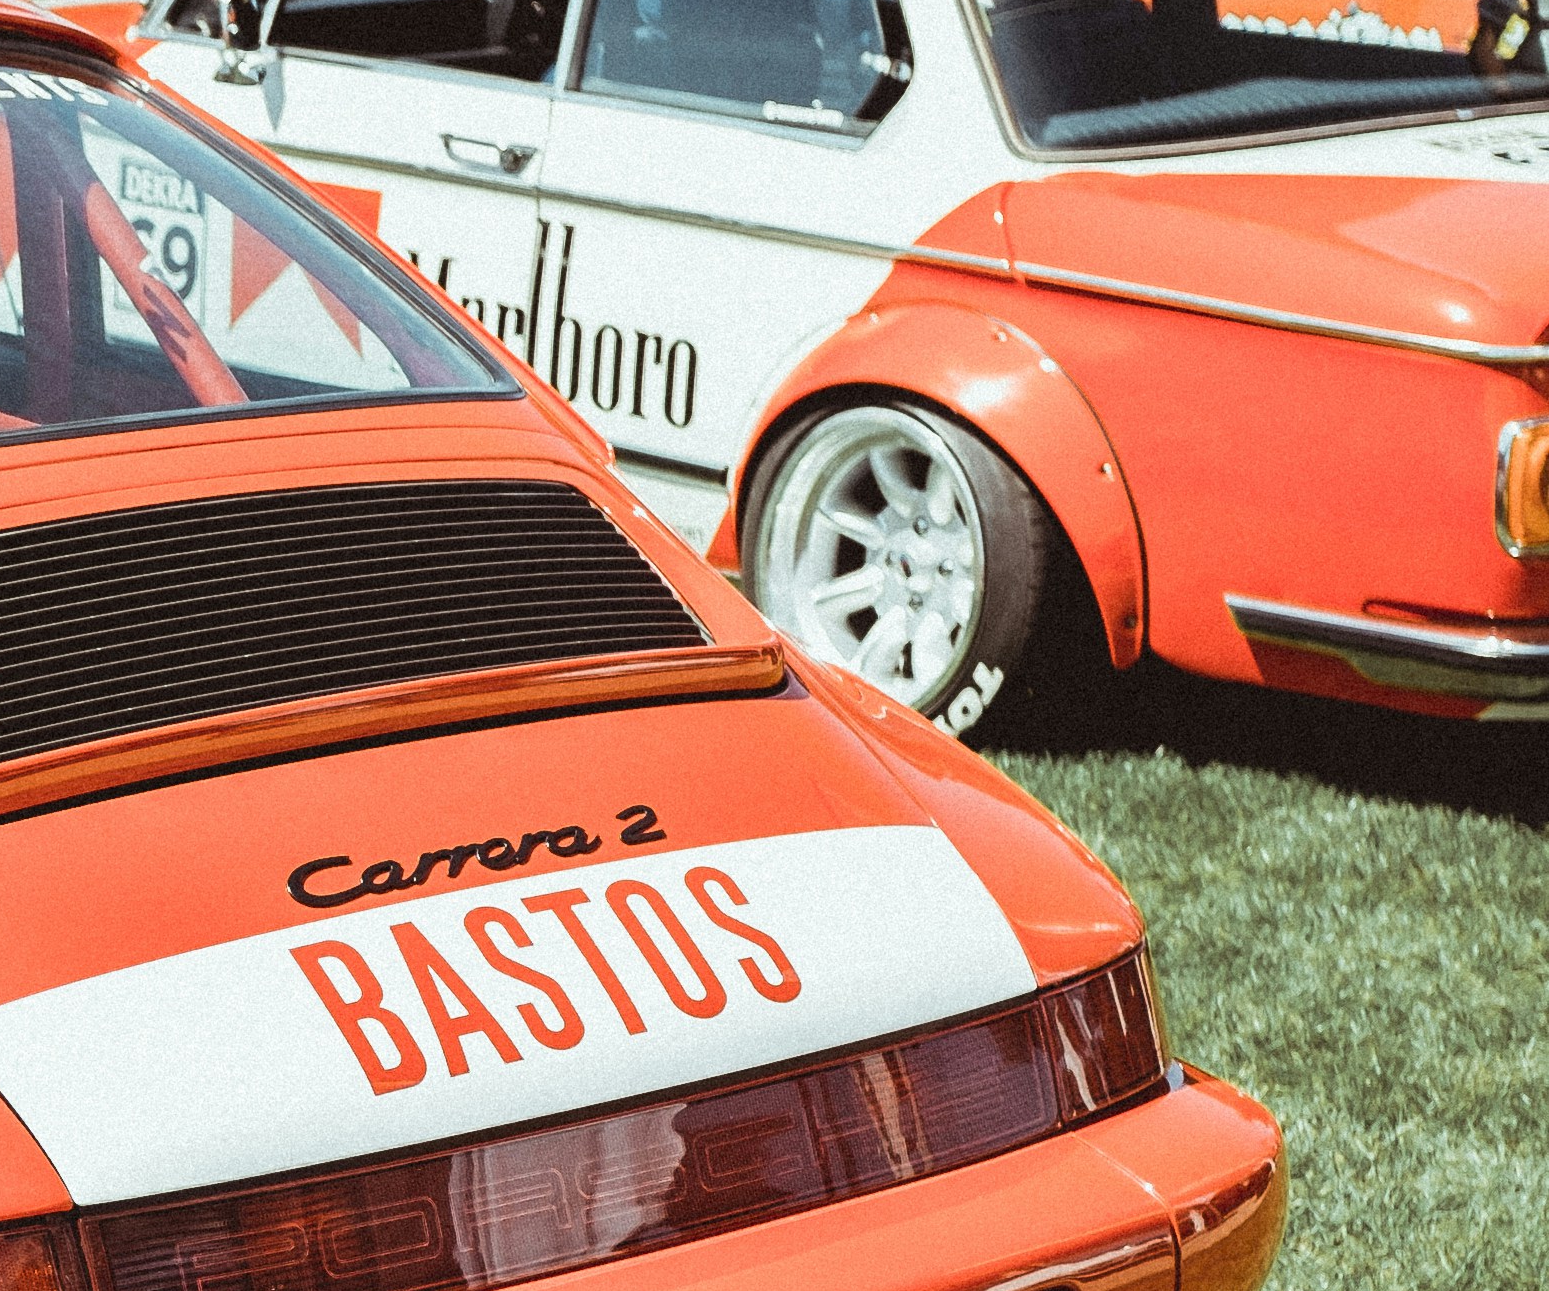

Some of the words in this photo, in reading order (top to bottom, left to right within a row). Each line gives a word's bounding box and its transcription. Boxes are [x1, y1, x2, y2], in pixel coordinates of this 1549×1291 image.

[124, 165, 198, 214] DEKRA
[286, 823, 602, 909] Carrera
[616, 804, 667, 845] 2
[288, 865, 803, 1097] BASTOS
